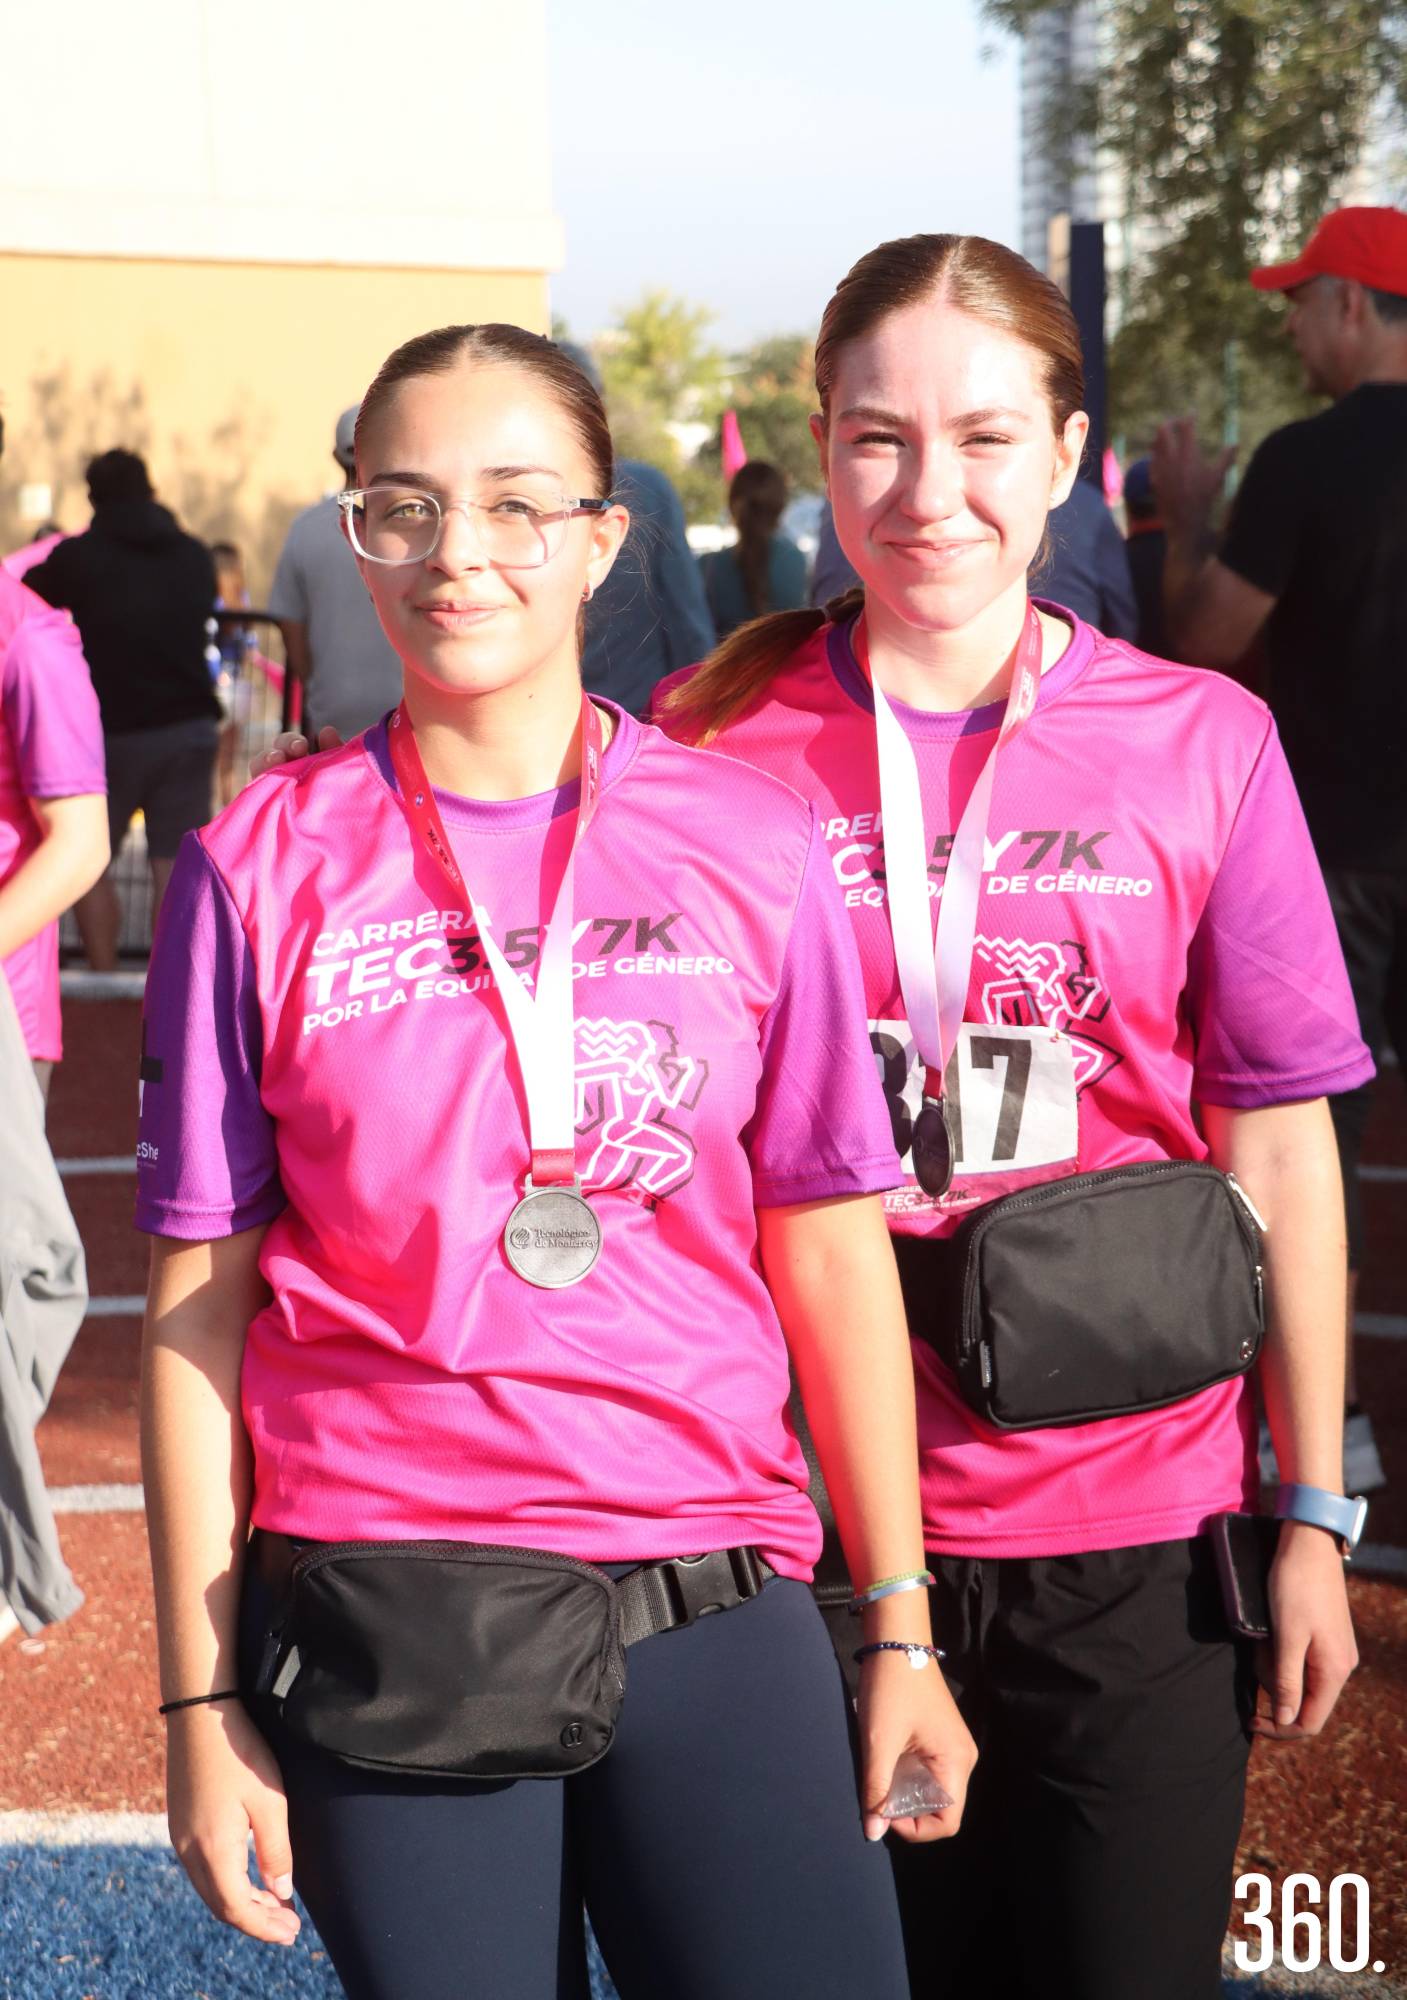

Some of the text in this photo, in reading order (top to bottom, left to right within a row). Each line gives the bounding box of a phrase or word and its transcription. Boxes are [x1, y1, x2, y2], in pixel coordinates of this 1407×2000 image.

[986, 870, 1153, 897] DE GÉNERO
[312, 909, 492, 957] CARRERA
[303, 1000, 362, 1035] POR
[370, 989, 408, 1014] LA
[572, 960, 607, 980] DE
[614, 952, 735, 976] GÉNERO
